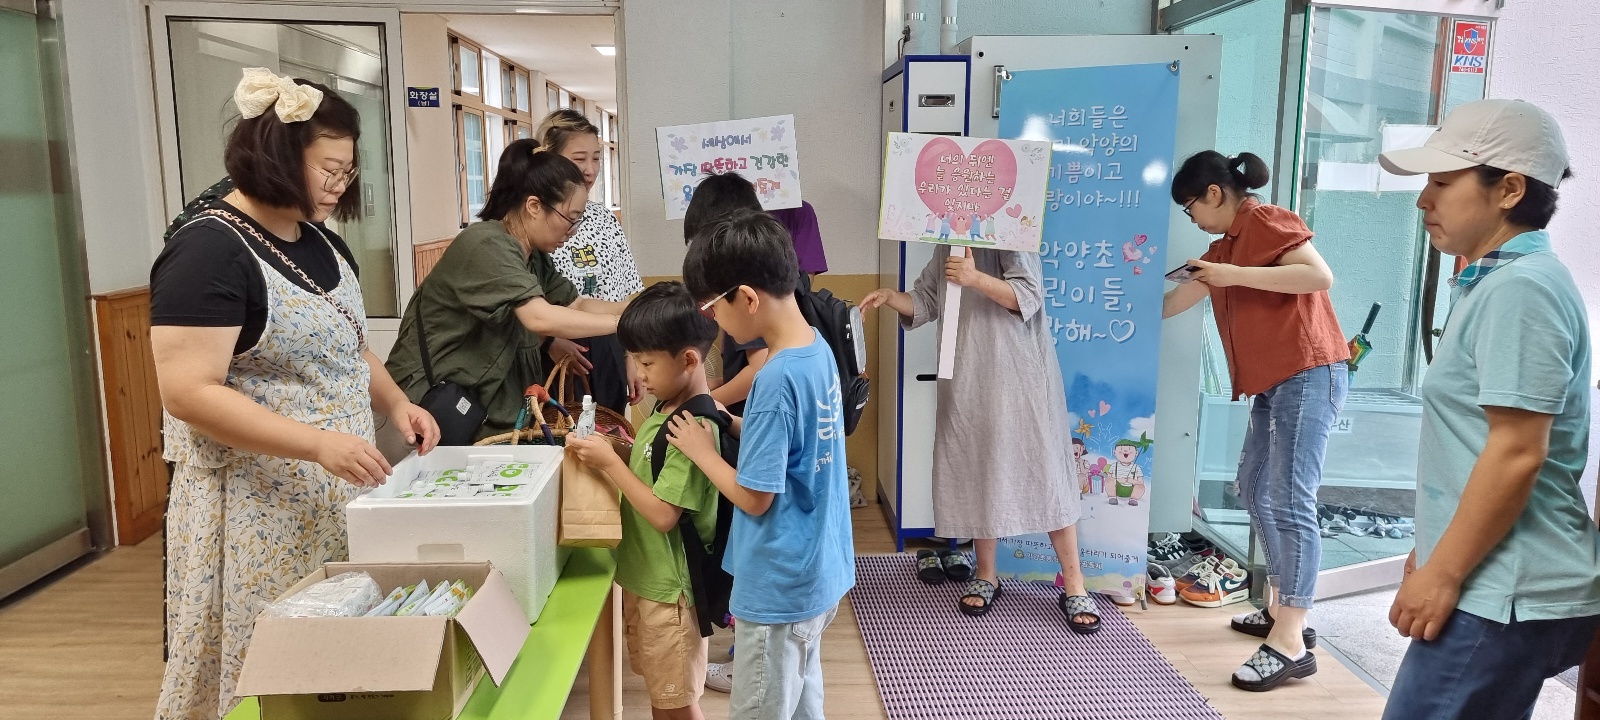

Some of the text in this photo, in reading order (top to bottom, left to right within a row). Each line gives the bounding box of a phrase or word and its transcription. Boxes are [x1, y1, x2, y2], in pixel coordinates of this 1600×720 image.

[1454, 56, 1483, 67] KNS
[409, 91, 437, 100] 화장실
[1049, 105, 1128, 129] 너희들은
[702, 134, 751, 149] 세상에서
[1079, 133, 1138, 156] 악양의
[669, 153, 789, 176] 가장 따뜻하고 건강한
[940, 154, 995, 168] 너의 뒤엔
[936, 166, 995, 184] 늘 응원하는
[1050, 162, 1124, 184] 기쁨이고
[918, 181, 1012, 201] 우리가 있다는 걸
[1046, 189, 1140, 211] 랑이야~!!!
[944, 198, 980, 212] 잊지마
[1039, 240, 1115, 269] 악양초
[1044, 277, 1133, 312] 린이들,
